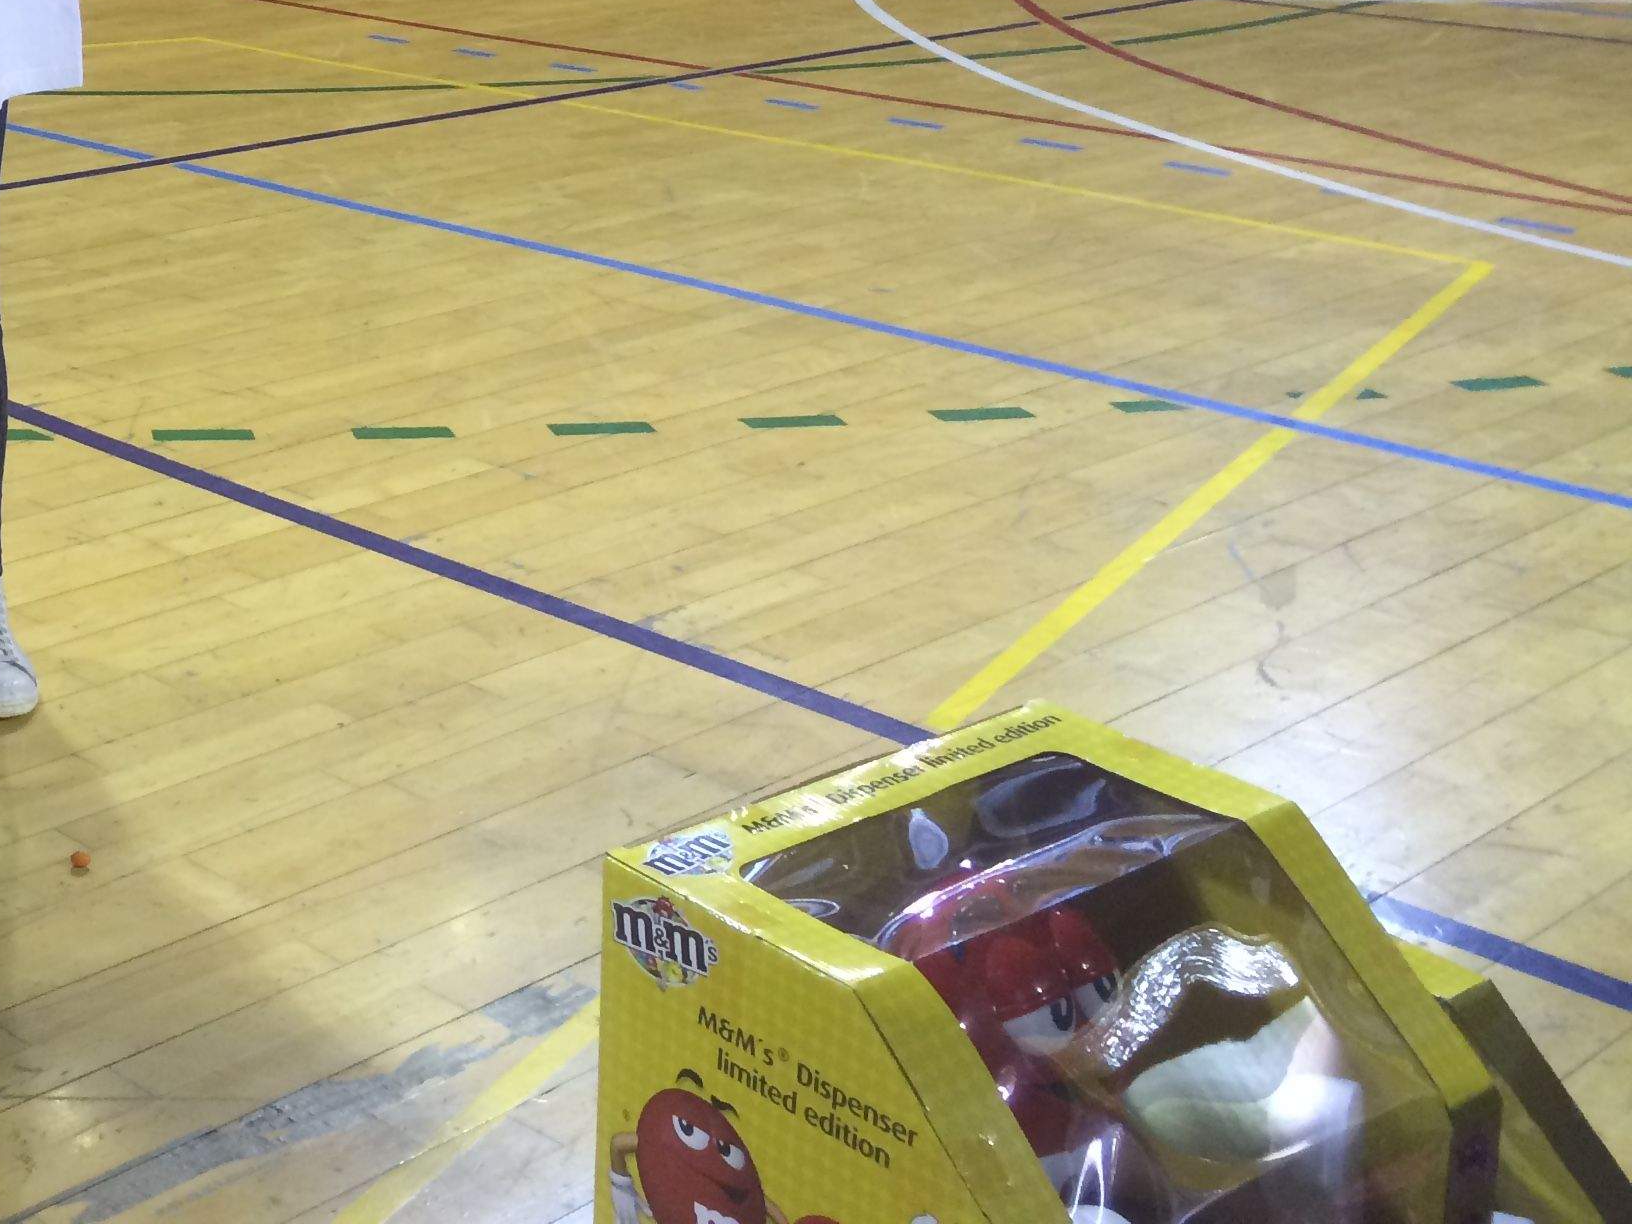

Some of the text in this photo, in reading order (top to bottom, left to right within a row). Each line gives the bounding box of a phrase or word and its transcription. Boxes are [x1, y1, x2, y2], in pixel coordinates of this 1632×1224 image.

[919, 736, 996, 769] limited
[993, 715, 1062, 745] edition
[717, 1047, 892, 1169] limited edition
[796, 1062, 919, 1148] Dispenser
